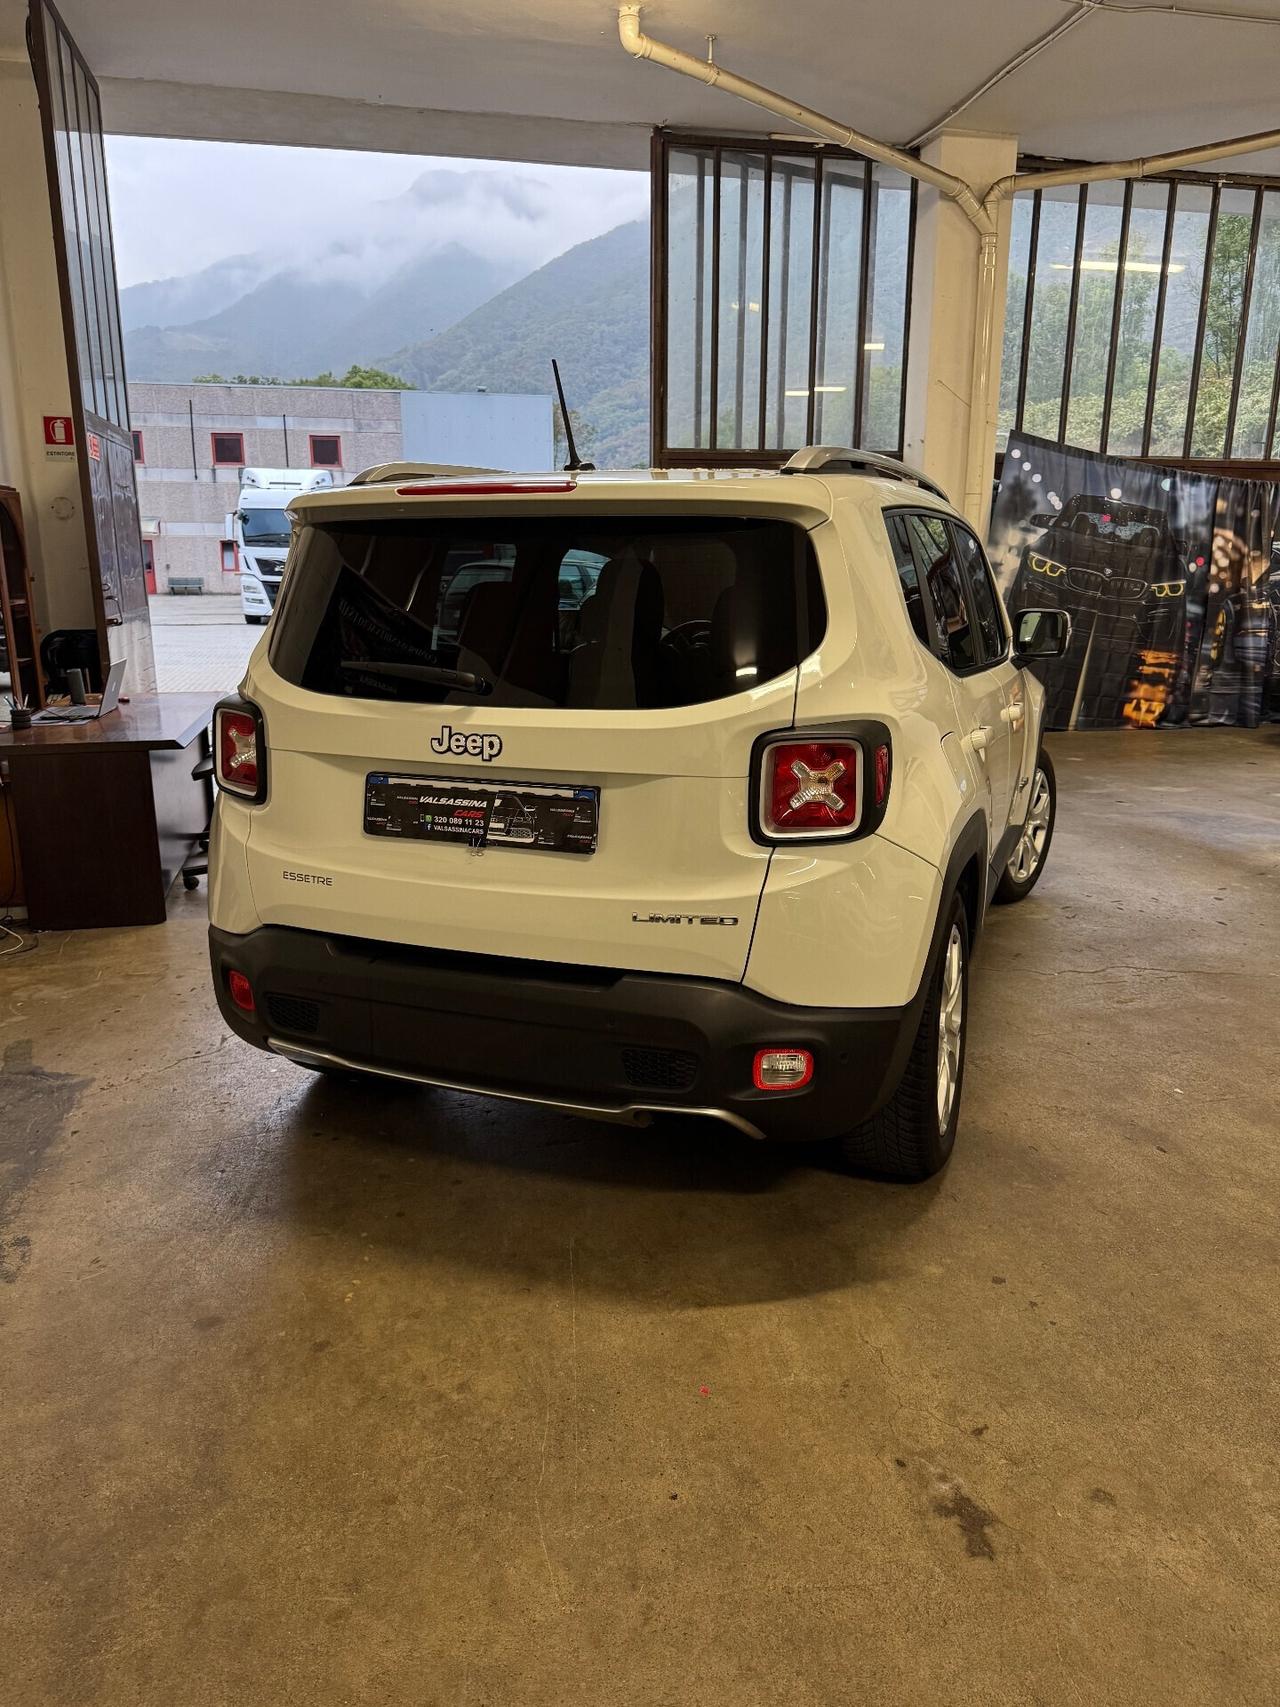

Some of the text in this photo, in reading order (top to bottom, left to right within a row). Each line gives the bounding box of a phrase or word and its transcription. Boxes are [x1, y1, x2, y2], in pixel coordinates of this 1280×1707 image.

[430, 726, 503, 762] Jeep
[419, 795, 488, 808] VALSASSINA
[454, 809, 485, 818] CARS
[433, 815, 485, 827] 320 089 11 23
[433, 825, 485, 835] VALSASSINACARS
[282, 870, 333, 887] ESSETRE
[632, 911, 739, 926] LIMITED
